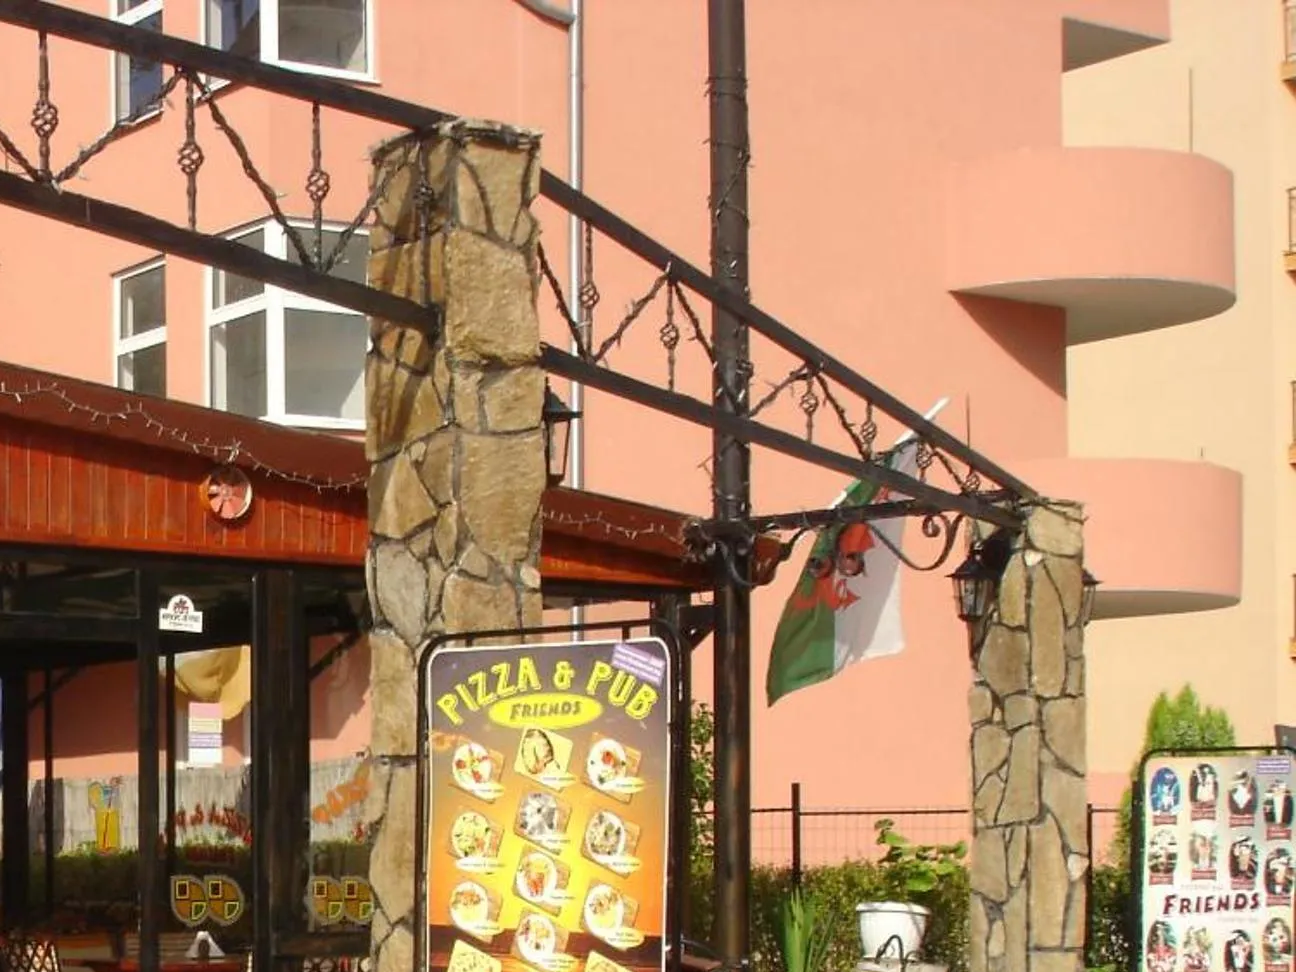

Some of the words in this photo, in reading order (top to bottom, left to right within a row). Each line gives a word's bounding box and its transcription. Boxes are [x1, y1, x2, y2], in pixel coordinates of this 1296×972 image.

[437, 656, 541, 725] PIZZA
[553, 661, 575, 690] &
[586, 660, 659, 720] PUB
[510, 700, 582, 721] FRIENDS
[1163, 892, 1260, 915] FRIENDS
